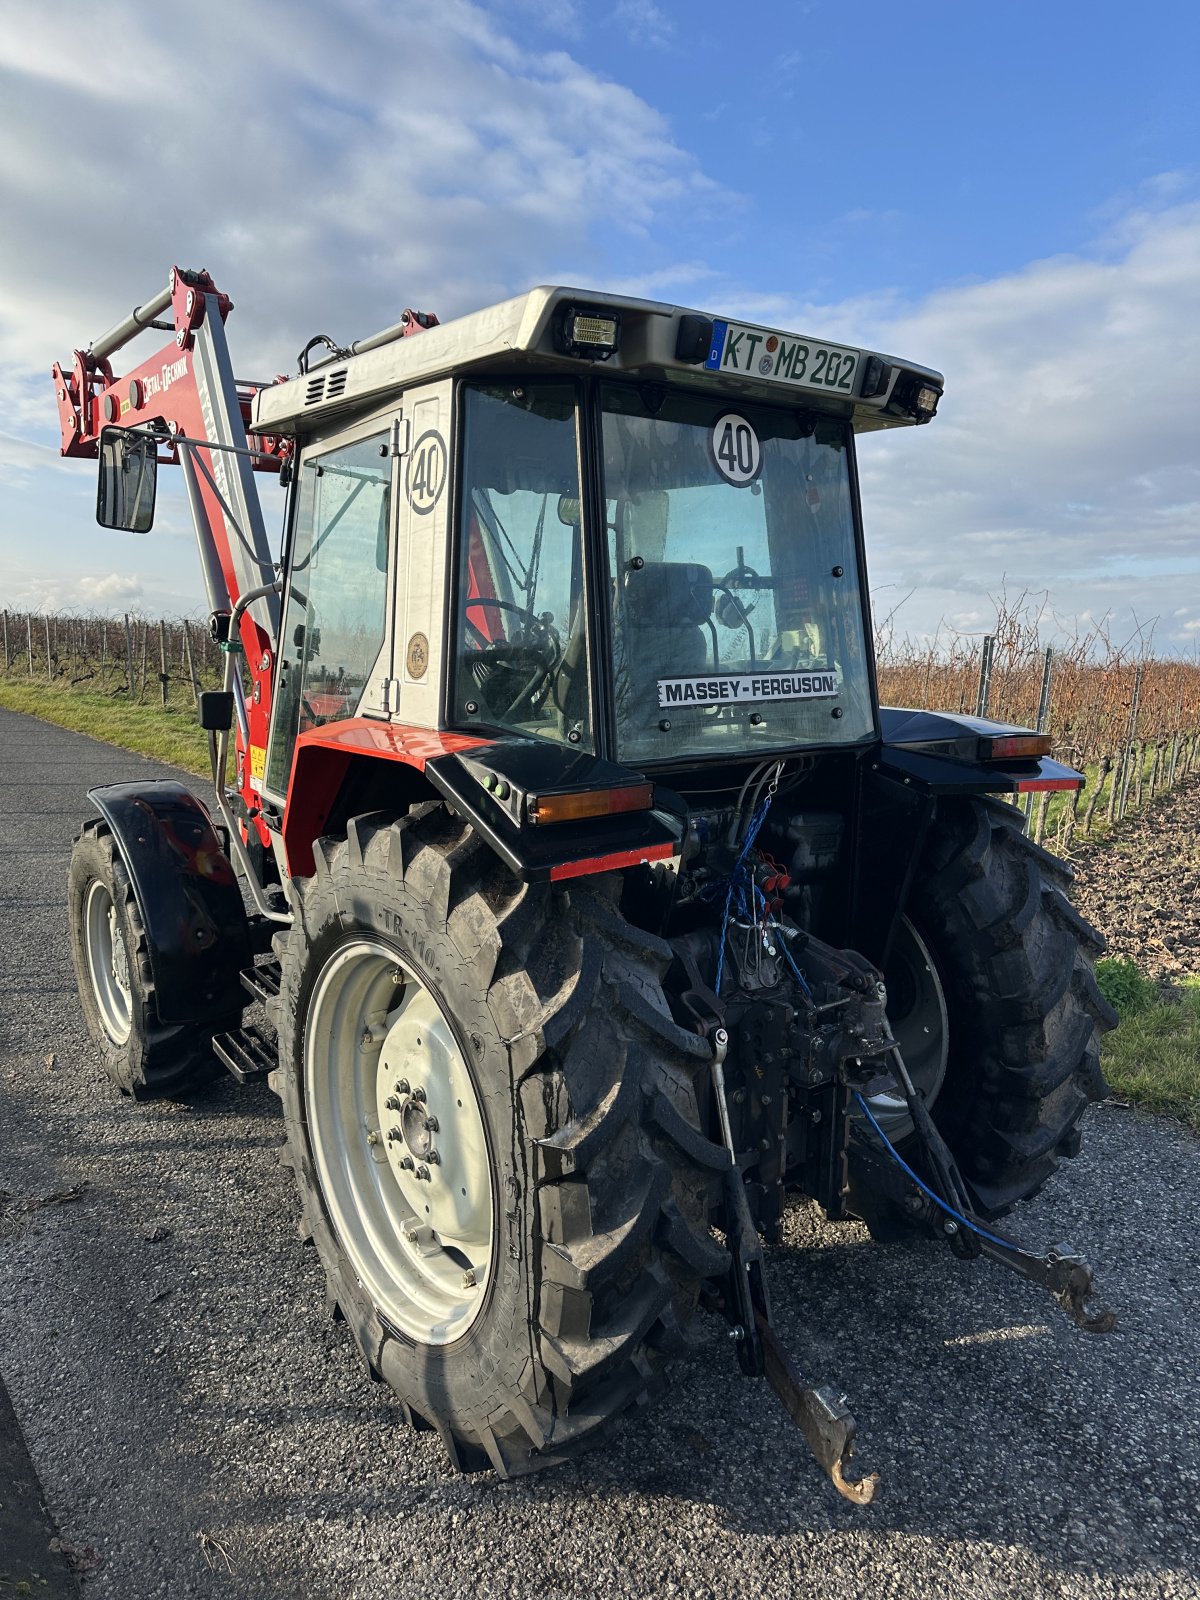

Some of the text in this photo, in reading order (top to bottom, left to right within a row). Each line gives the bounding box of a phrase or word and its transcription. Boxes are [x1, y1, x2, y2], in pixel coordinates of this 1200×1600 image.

[711, 350, 718, 361] D
[723, 330, 856, 388] KT MB 202
[413, 445, 438, 499] 40
[718, 422, 753, 474] 40
[665, 675, 834, 702] MASSEY-FERGUSON
[382, 907, 436, 970] TR-110
